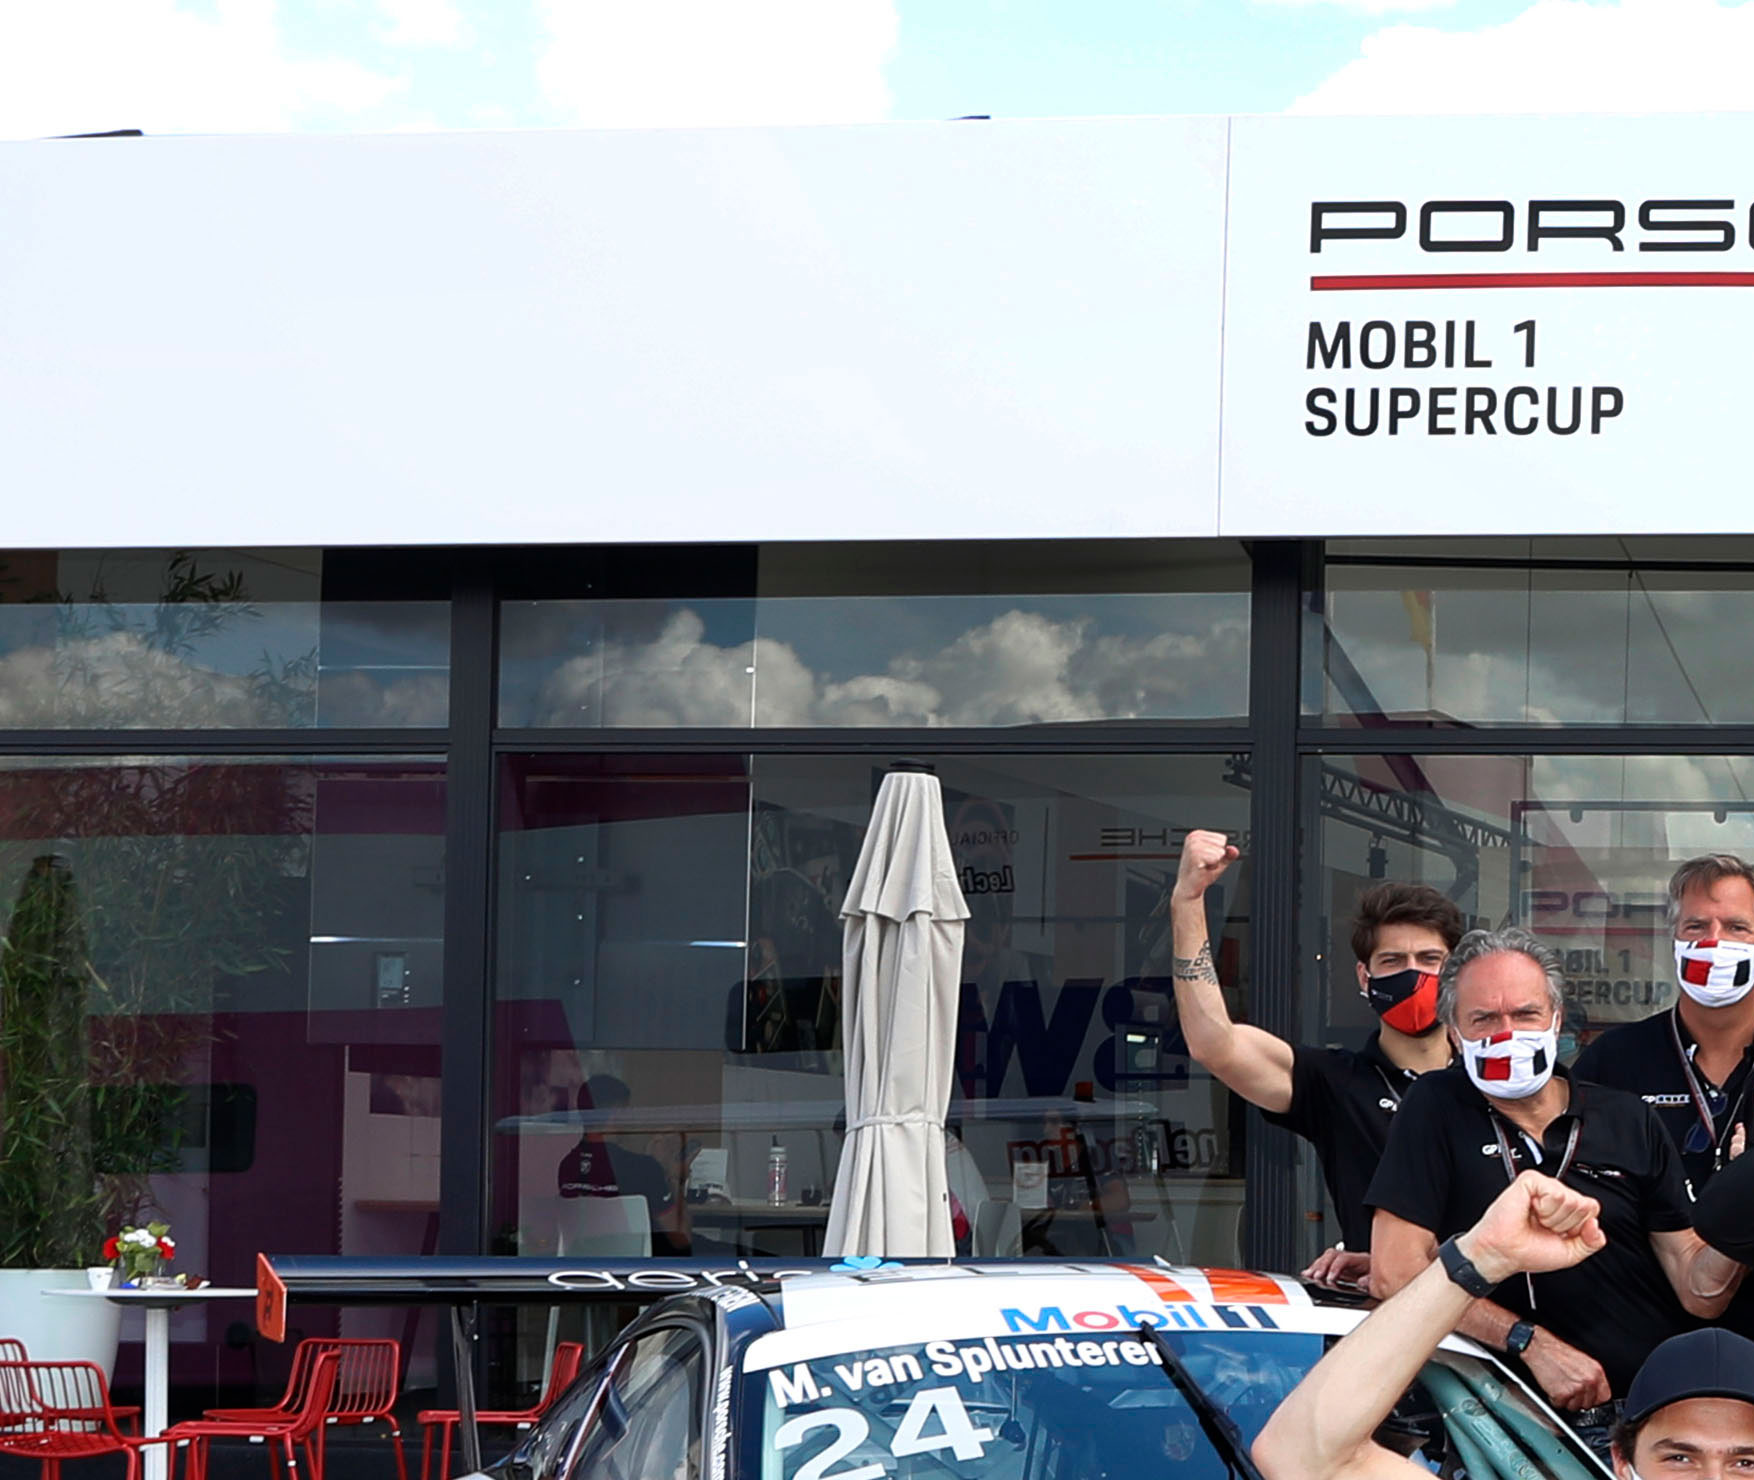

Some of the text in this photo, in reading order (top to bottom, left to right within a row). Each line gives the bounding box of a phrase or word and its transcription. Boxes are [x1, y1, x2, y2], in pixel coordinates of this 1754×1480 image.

[1304, 319, 1539, 370] MOBIL 1
[1303, 385, 1625, 437] SUPERCUP
[1000, 1303, 1278, 1333] Mobil 1
[767, 1367, 831, 1409] M.
[834, 1352, 921, 1393] van
